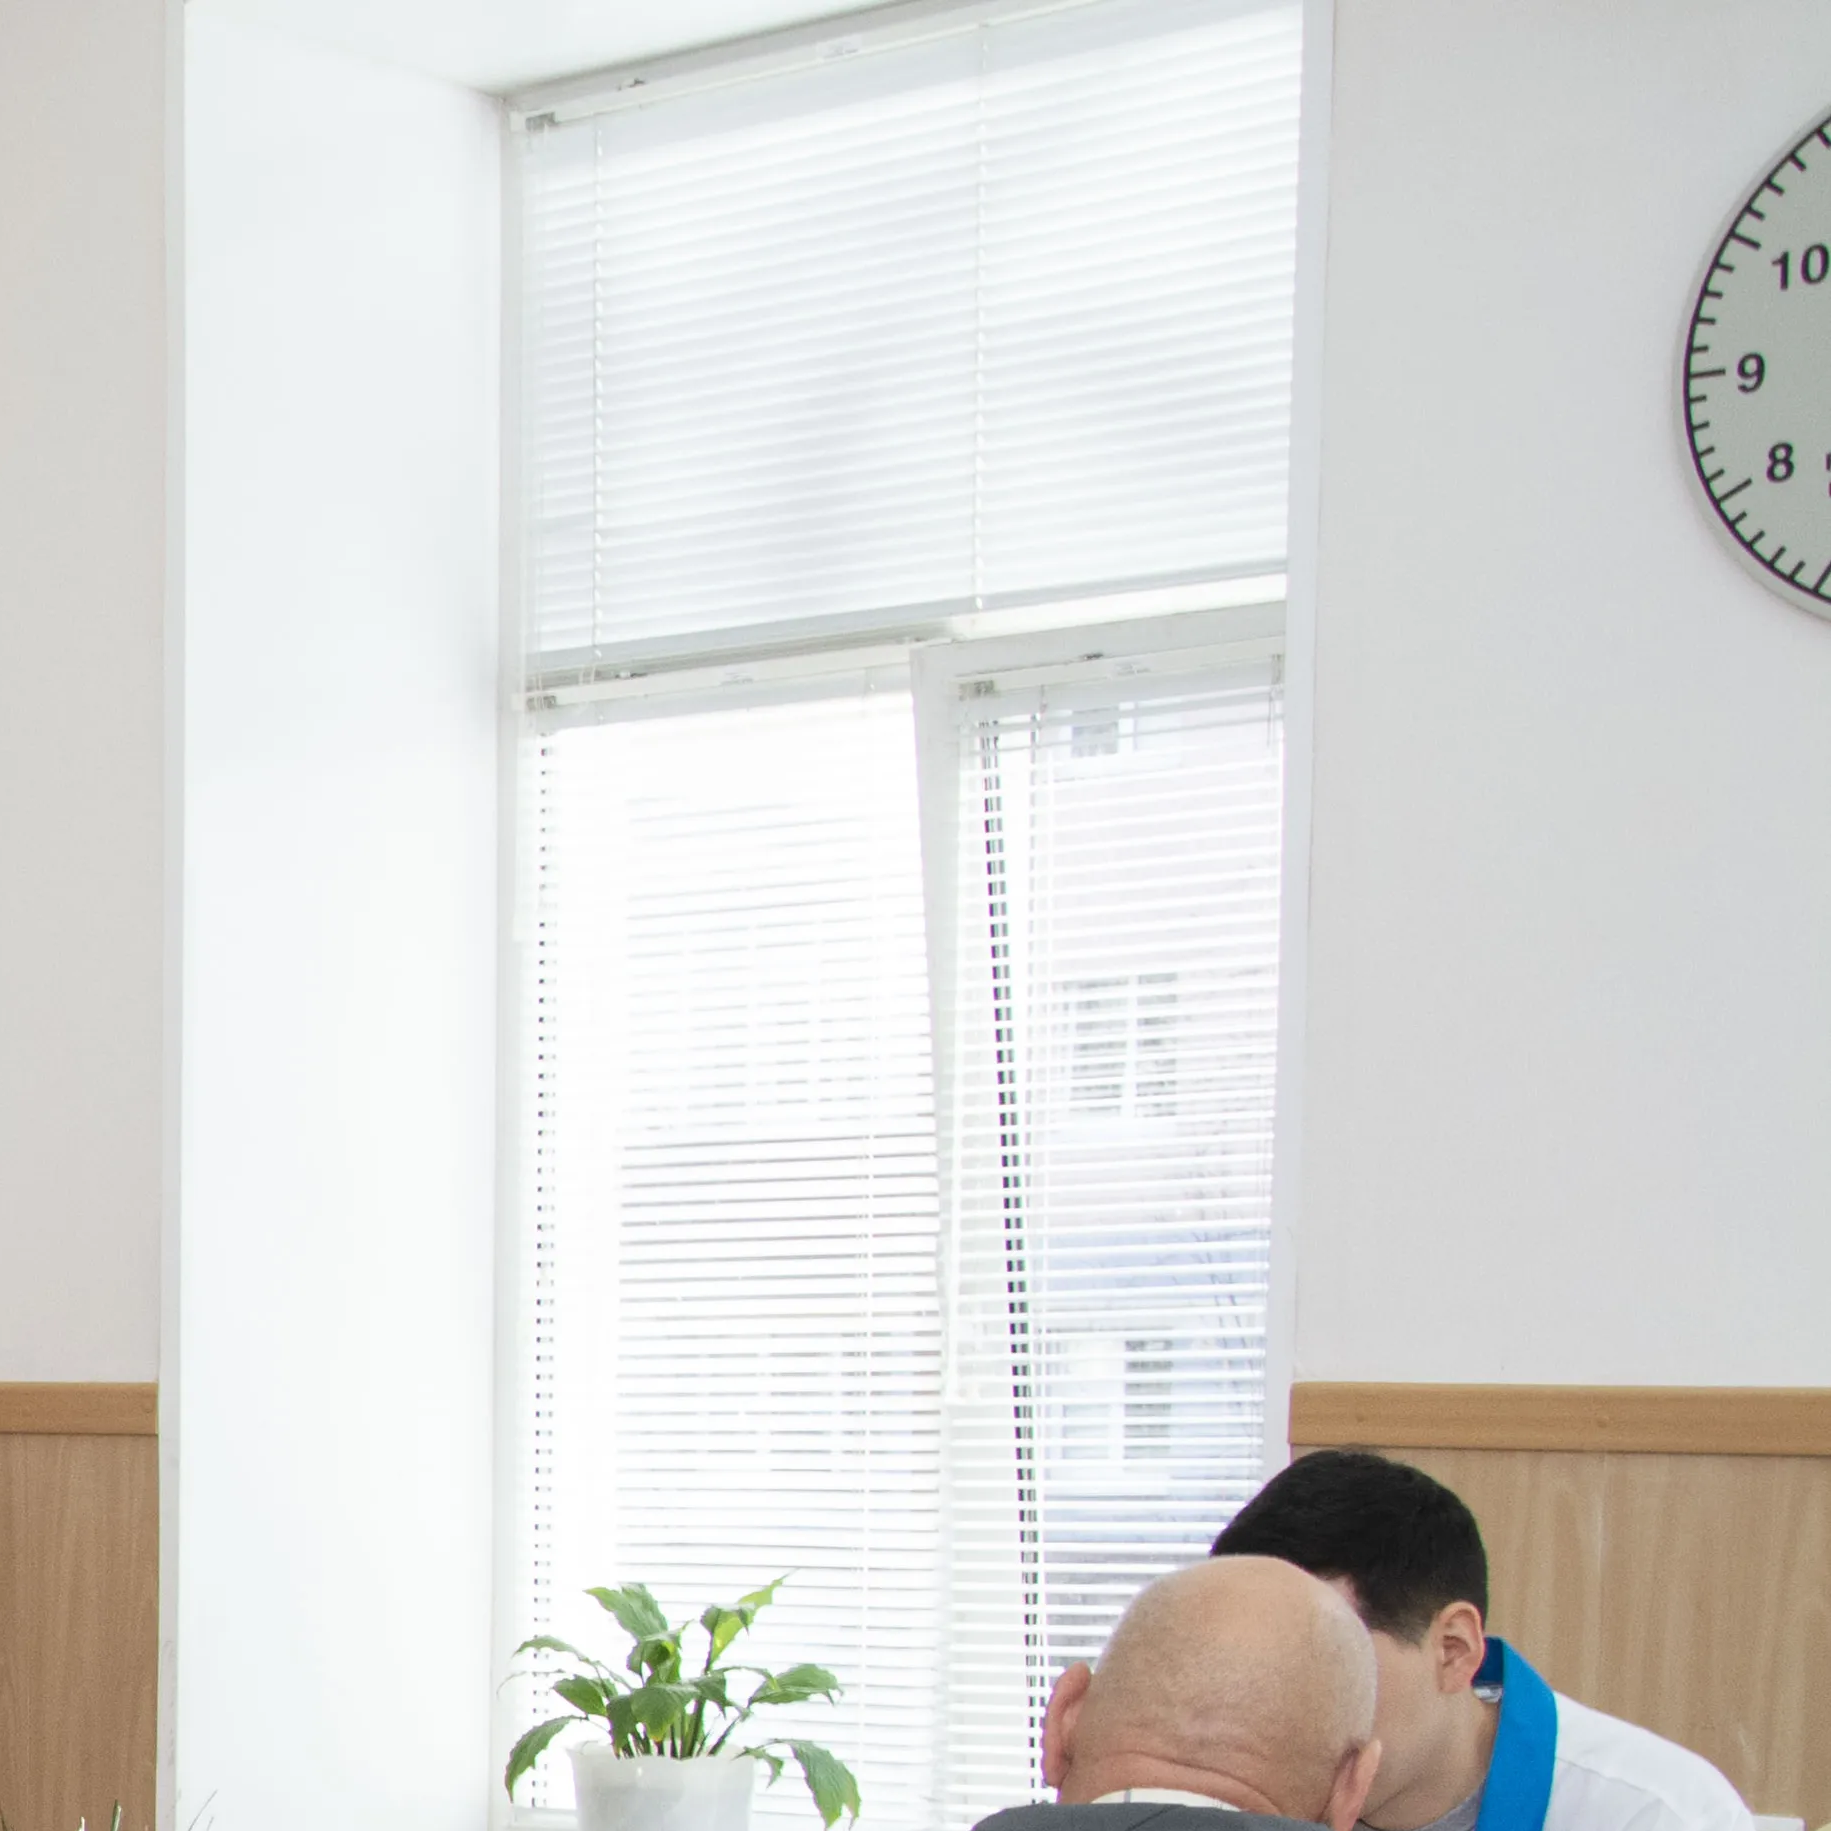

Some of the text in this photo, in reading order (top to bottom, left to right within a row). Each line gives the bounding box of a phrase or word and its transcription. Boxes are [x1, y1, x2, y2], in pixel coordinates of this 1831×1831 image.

[1771, 243, 1830, 291] 10
[1737, 352, 1765, 393] 9
[1766, 442, 1794, 483] 8
